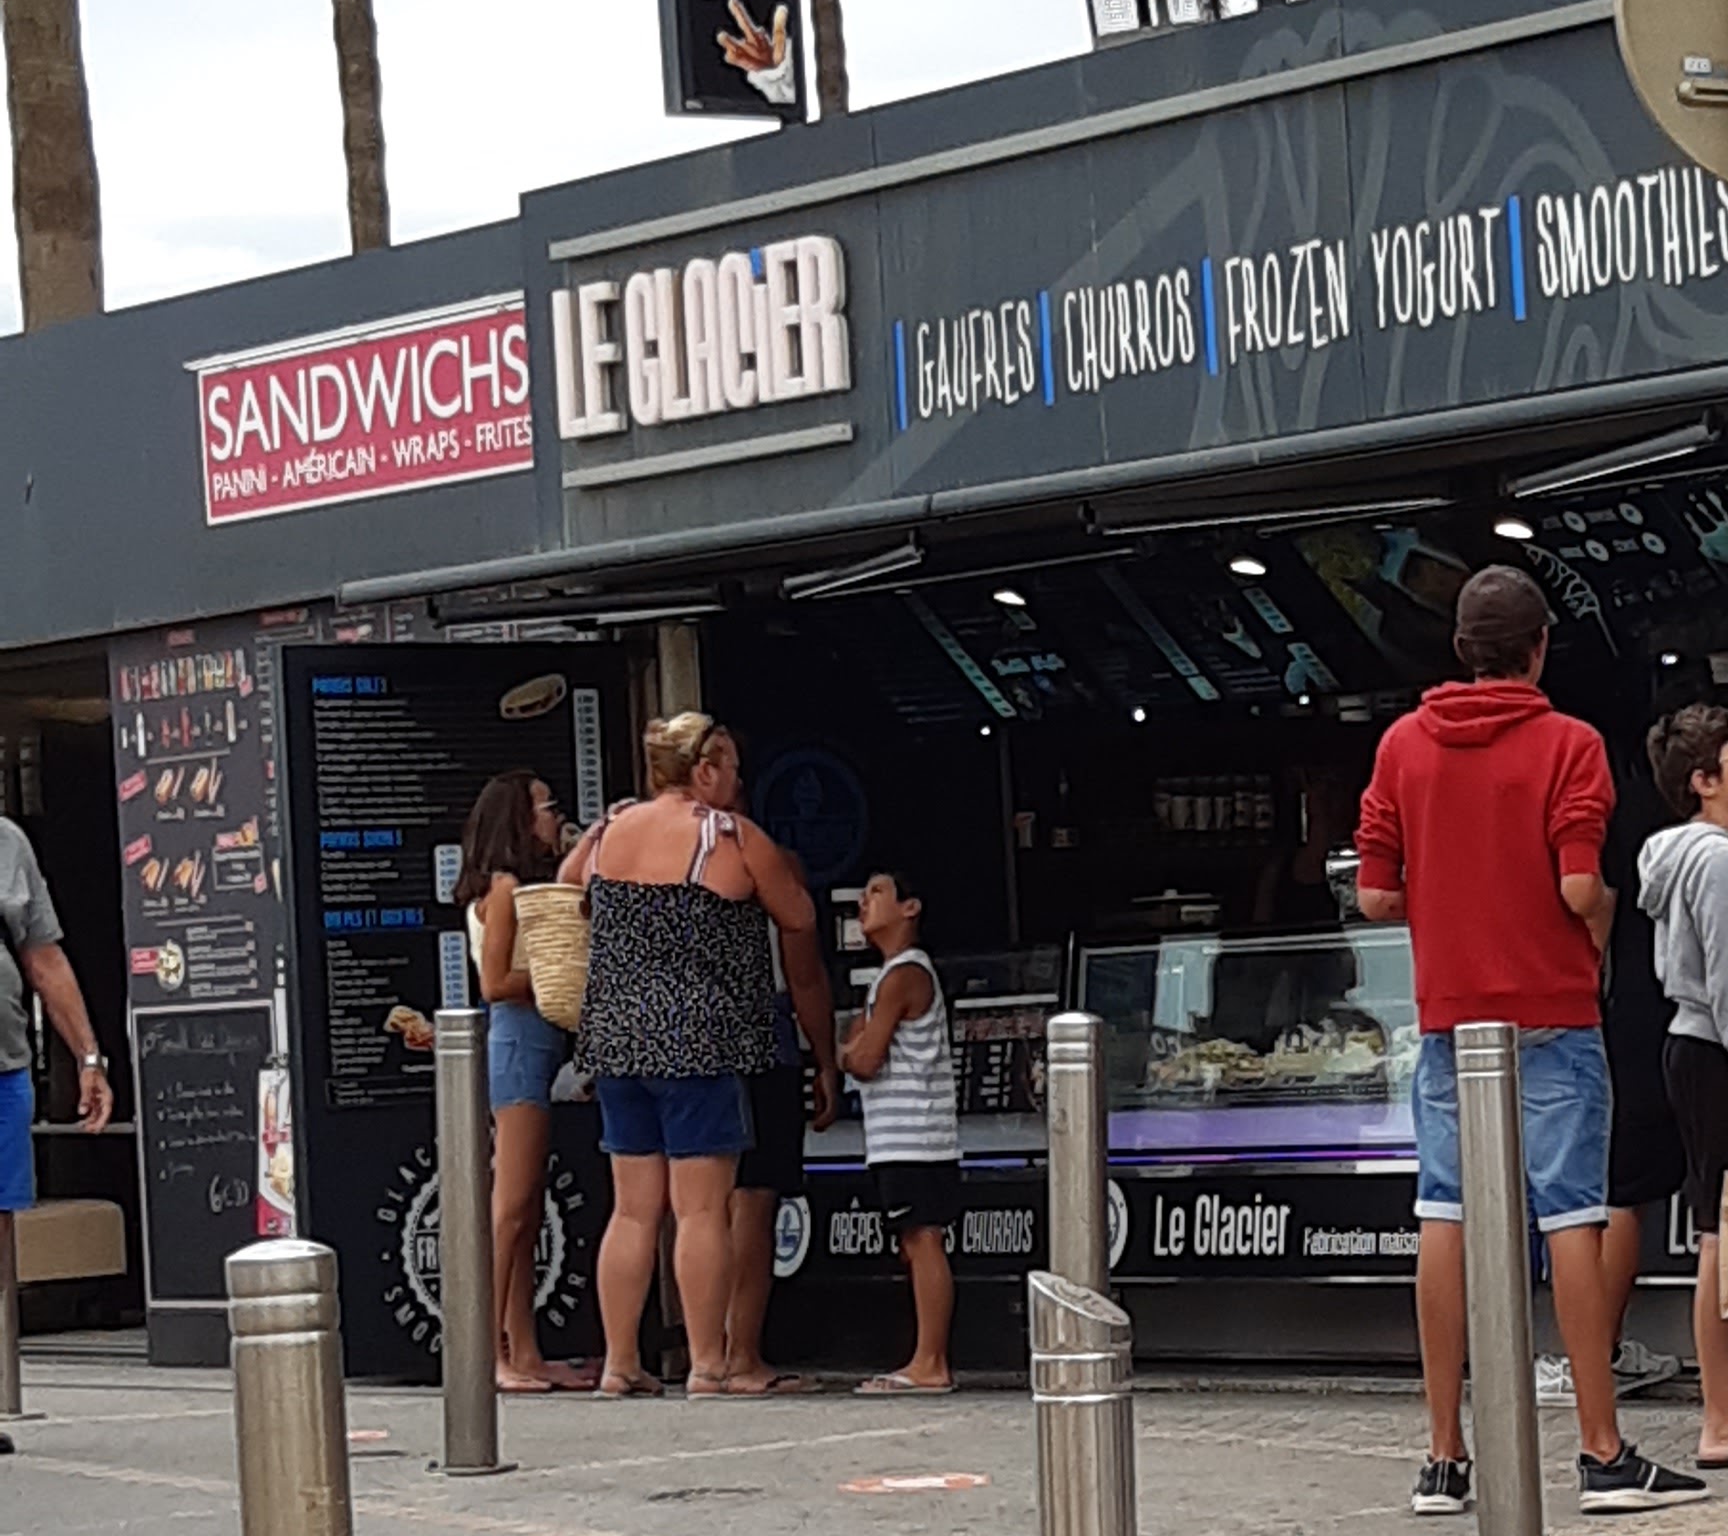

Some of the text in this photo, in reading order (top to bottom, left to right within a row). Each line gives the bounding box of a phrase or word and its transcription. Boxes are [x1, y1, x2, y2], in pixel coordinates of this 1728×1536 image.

[916, 299, 1036, 419] GAUFRES
[1063, 267, 1195, 393] CHURROS
[1224, 238, 1351, 365] FROZEN
[1370, 206, 1500, 330] YOGURT
[207, 323, 530, 462] SANDWICHS
[552, 281, 628, 440] LE
[212, 463, 267, 502] PANINI
[391, 428, 460, 469] WRAPS
[475, 414, 533, 453] FRITES
[961, 1209, 1035, 1254] CHURROS
[1153, 1192, 1291, 1256] Le Glacier
[1378, 1226, 1421, 1256] maiso
[547, 1272, 588, 1328] BAR
